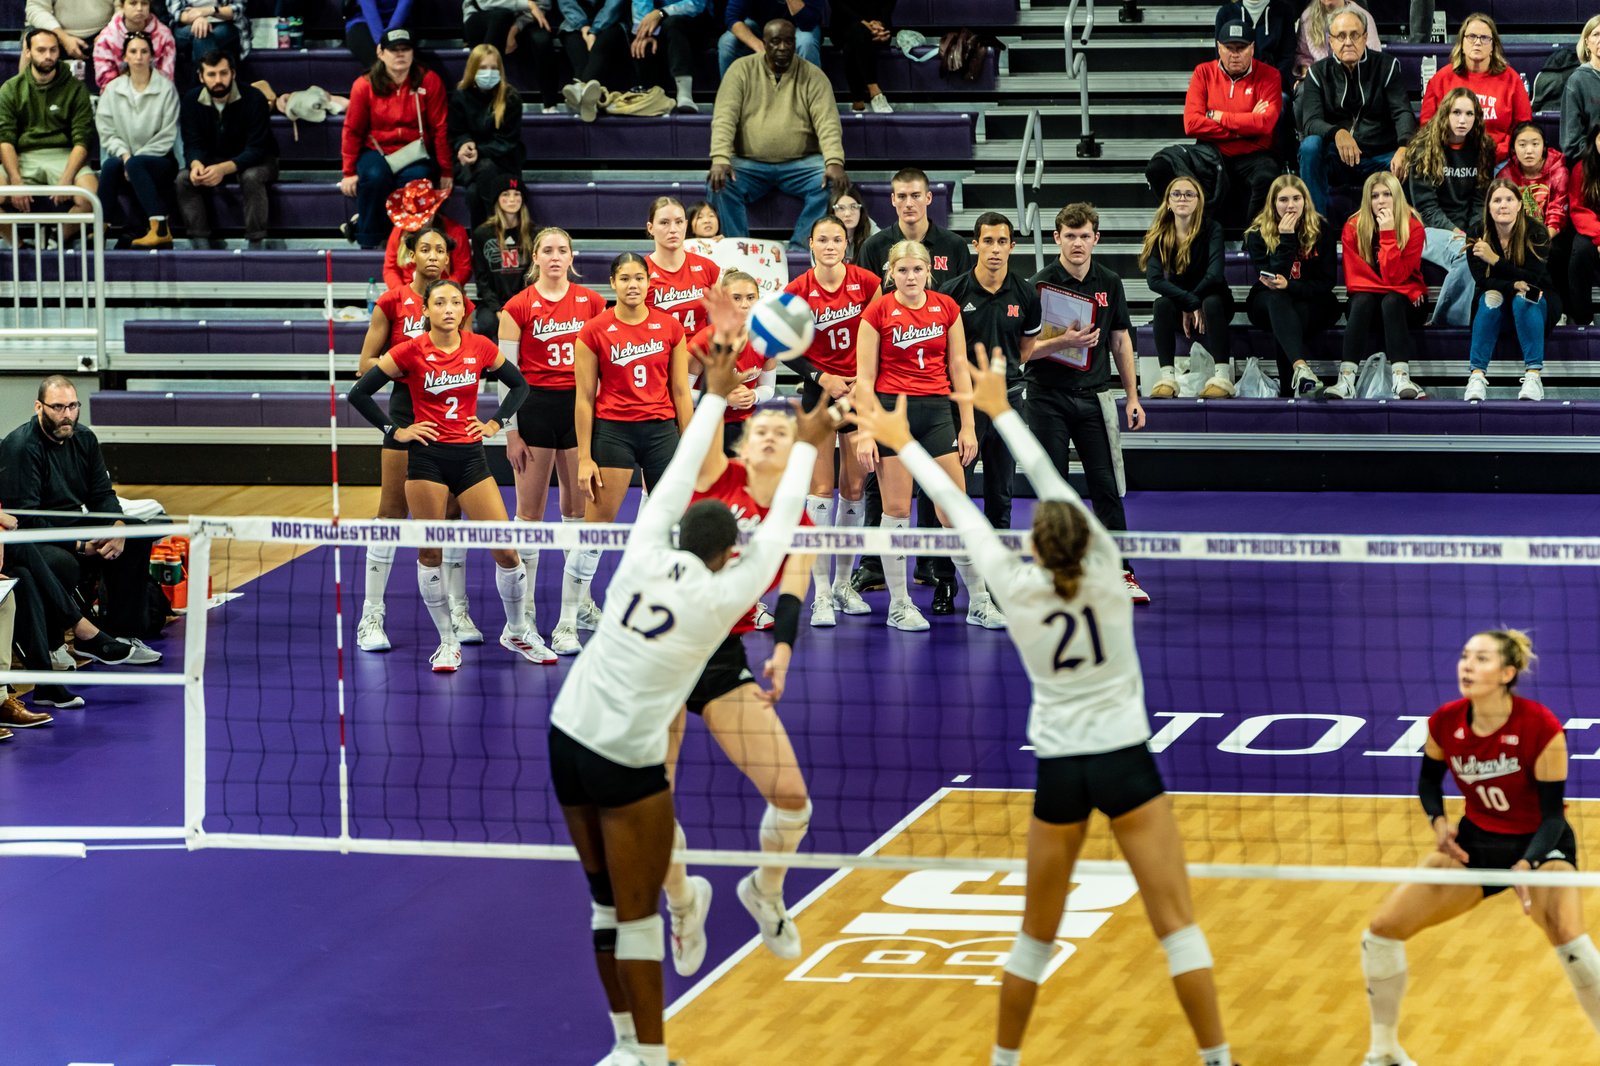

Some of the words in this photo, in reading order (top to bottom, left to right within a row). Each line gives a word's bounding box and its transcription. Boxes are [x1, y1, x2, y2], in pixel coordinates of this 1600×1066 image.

[1443, 166, 1478, 177] BRASKA
[502, 249, 519, 268] N
[933, 255, 948, 271] N
[653, 284, 704, 305] Nebraska
[1095, 292, 1109, 307] N
[811, 301, 862, 325] Nebraska
[1007, 304, 1020, 318] N
[532, 316, 585, 336] Nebraska
[892, 321, 944, 344] Nebraska
[610, 338, 664, 362] Nebraska
[827, 327, 851, 351] 13
[547, 342, 575, 367] 33
[916, 347, 925, 369] 1
[424, 368, 477, 389] Nebraska
[633, 364, 647, 388] 9
[445, 396, 459, 419] 2
[271, 521, 400, 541] NORTHWESTERN
[425, 526, 554, 544] NORTHWESTERN
[790, 532, 865, 548] WESTERN
[1206, 538, 1341, 556] NORTHWESTERN
[1366, 540, 1503, 558] NORTHWESTERN
[1528, 543, 1600, 559] NORTHW
[163, 570, 172, 582] G
[621, 592, 675, 639] 12
[1041, 605, 1105, 674] 21
[1476, 785, 1510, 811] 10
